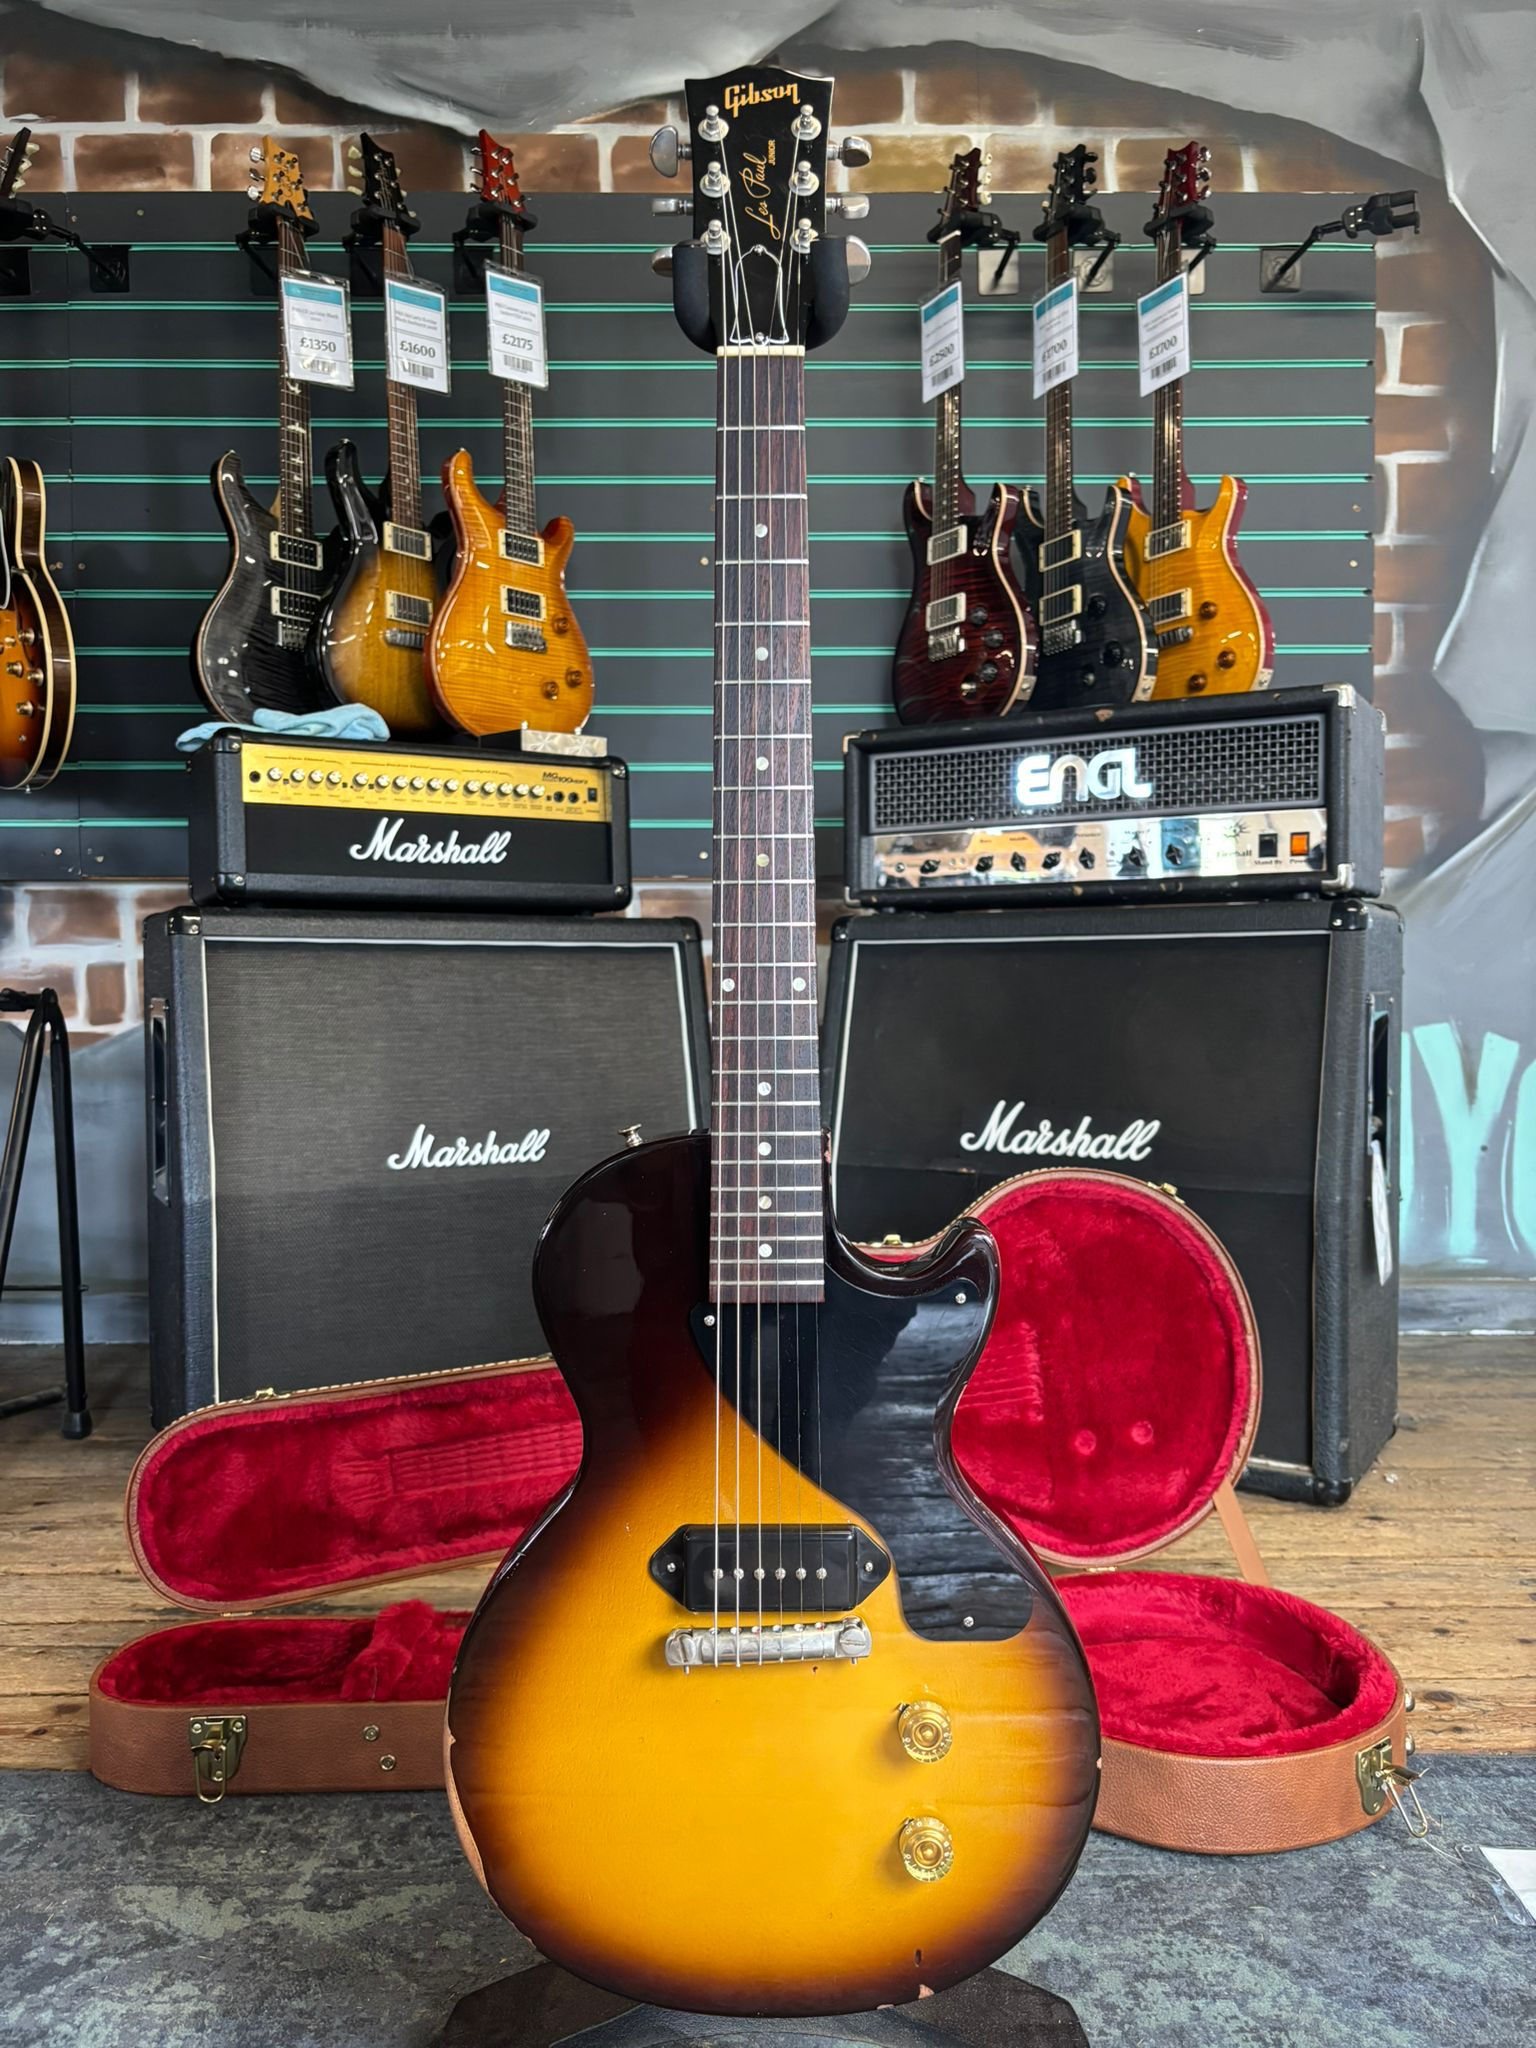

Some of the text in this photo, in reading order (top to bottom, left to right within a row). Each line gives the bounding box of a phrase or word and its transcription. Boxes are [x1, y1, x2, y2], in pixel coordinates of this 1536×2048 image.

[725, 82, 801, 118] Gibson
[768, 139, 776, 166] JUNIOR
[738, 152, 781, 240] Les Paul
[300, 336, 337, 353] £1350
[399, 340, 436, 358] £1600
[502, 333, 534, 351] £2175
[1149, 335, 1178, 359] £1700
[1016, 748, 1153, 806] ENGL
[349, 817, 512, 864] Marshall
[386, 1123, 551, 1170] Marshall
[960, 1100, 1161, 1162] Marshall
